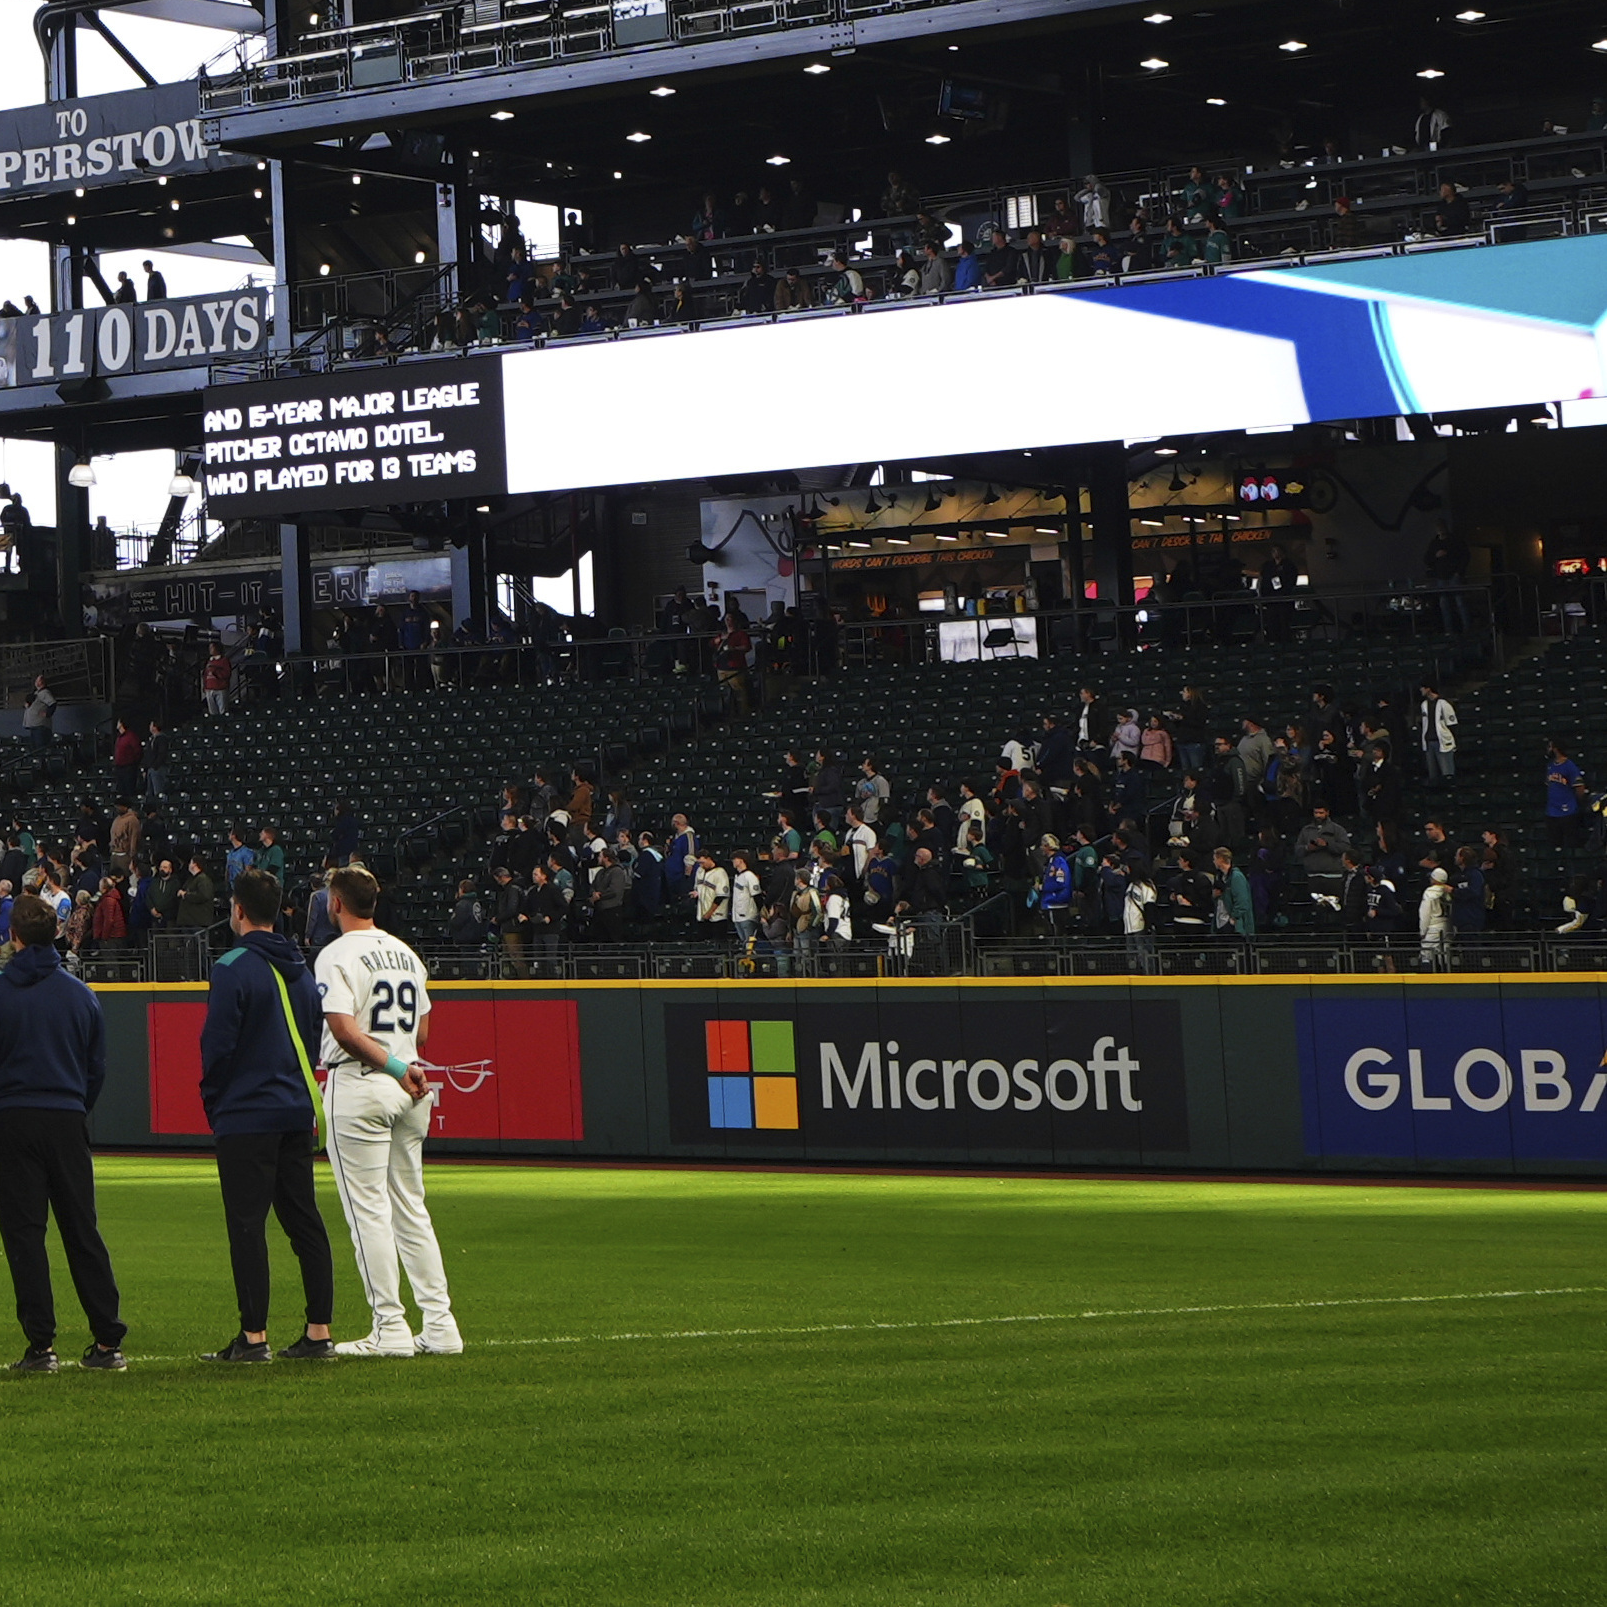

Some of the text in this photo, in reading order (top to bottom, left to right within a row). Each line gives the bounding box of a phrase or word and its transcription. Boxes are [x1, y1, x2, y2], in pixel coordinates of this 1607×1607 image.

[56, 108, 87, 139] TO
[32, 296, 260, 379] 110 DAYS
[204, 382, 480, 433] AND 15-YEAR MAJOR LEAGUE
[205, 436, 282, 465] PITCHER
[289, 427, 368, 456] OCTAVIO
[206, 449, 477, 496] WHO PLAYED FOR 13 TEAMS
[832, 559, 862, 569] WORDS
[957, 549, 995, 561] CHICKEN
[1161, 533, 1205, 548] DESCRE
[369, 980, 418, 1034] 29
[819, 1036, 1143, 1112] Microsoft
